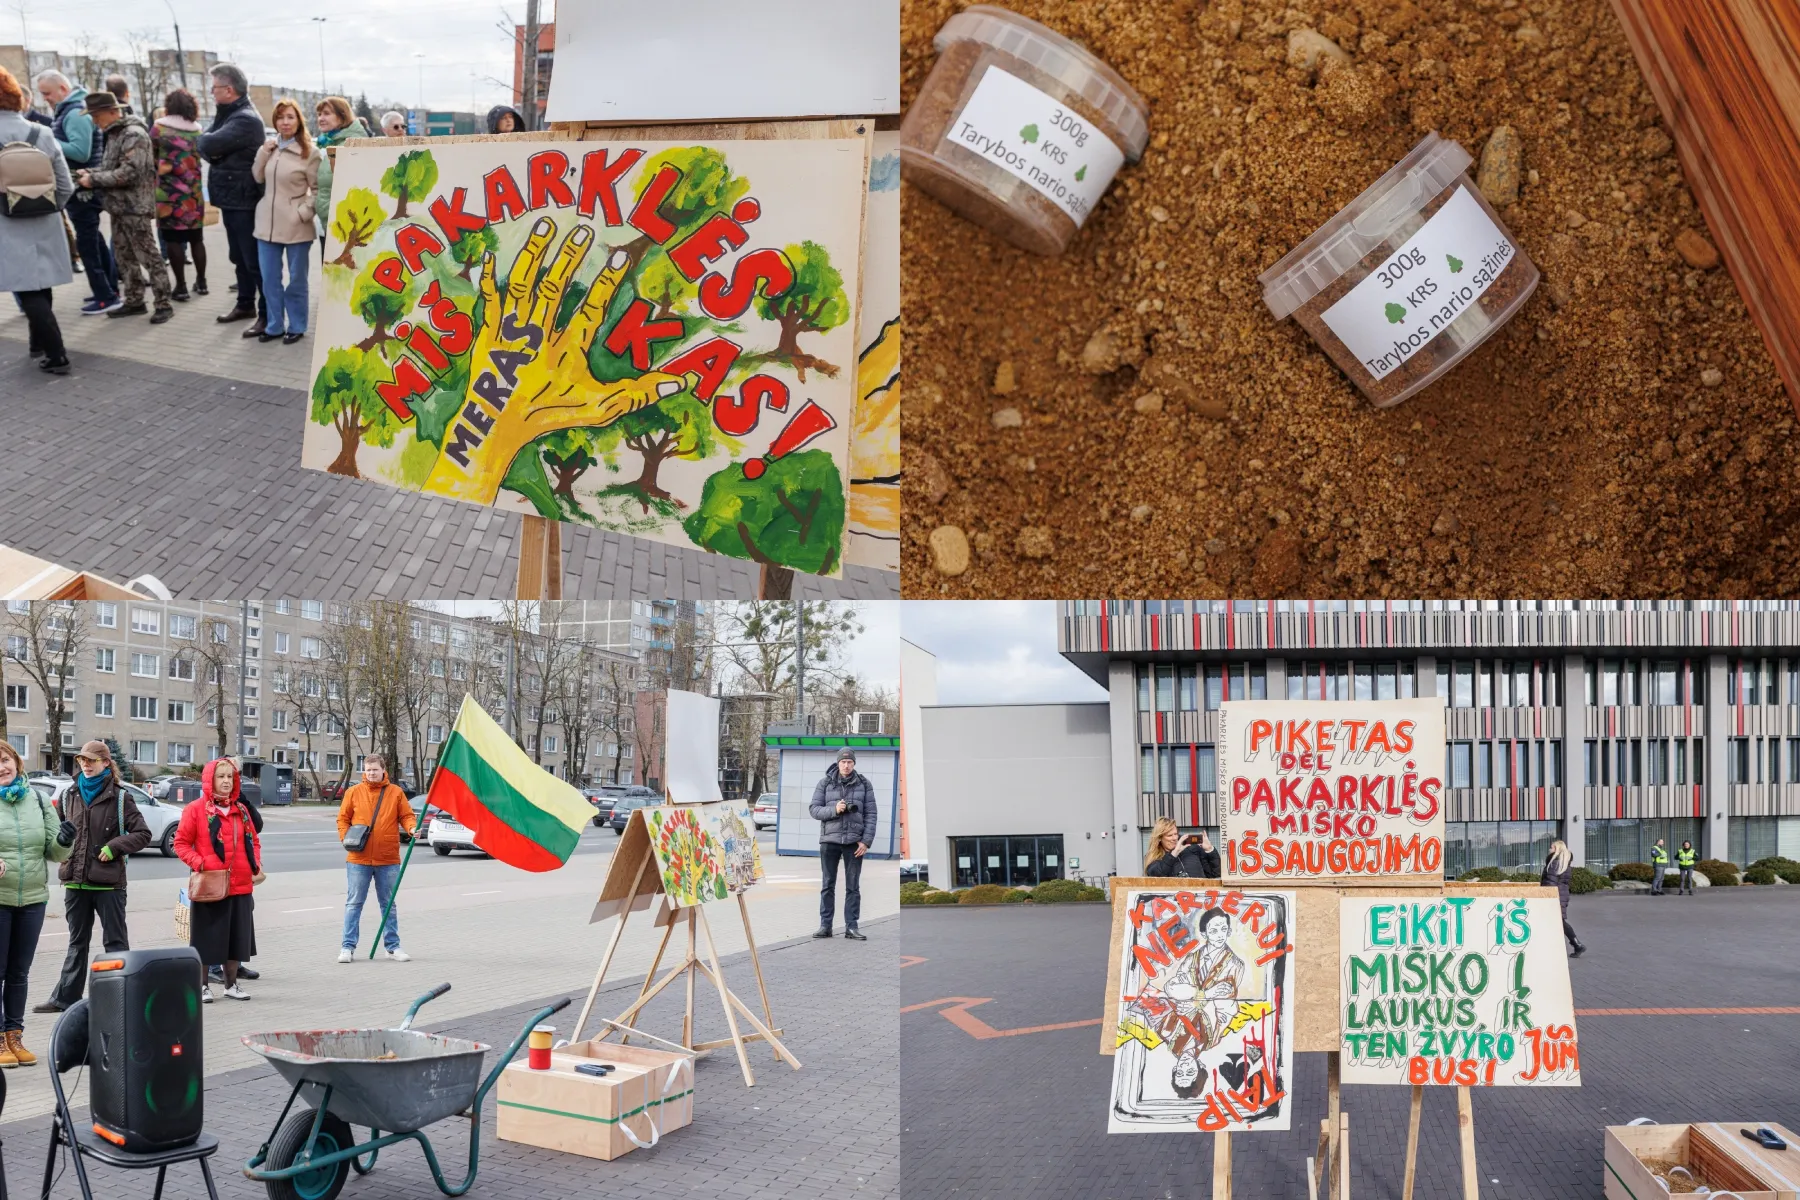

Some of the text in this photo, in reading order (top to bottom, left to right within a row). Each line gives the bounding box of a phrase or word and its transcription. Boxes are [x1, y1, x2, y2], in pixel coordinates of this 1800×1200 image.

[1048, 108, 1089, 149] 300g
[958, 121, 1027, 171] Tarybos
[1027, 162, 1067, 199] nario
[1040, 139, 1069, 166] KRS
[373, 147, 797, 321] PAKARKLĖS
[1376, 246, 1427, 290] 300g
[1366, 238, 1512, 375] Tarybos nario sąžinės
[1406, 277, 1438, 309] KRS
[444, 311, 545, 469] MERAS
[602, 296, 838, 481] KAS!
[1219, 709, 1228, 755] PAKARKLĖS
[1247, 719, 1416, 757] PIKETAS
[1219, 758, 1228, 786] MIŠKO
[1232, 760, 1442, 823] PAKARKLĖS
[1269, 805, 1377, 838] MIŠKO
[1227, 830, 1441, 875] IŠSAUGOJIMO
[1131, 914, 1200, 979] NE
[1348, 947, 1489, 996] MIŠKO
[1502, 996, 1534, 1030] IR
[1344, 1030, 1408, 1061] TEN
[1417, 1023, 1515, 1062] ŽVYRO
[1407, 1055, 1498, 1087] BUS!
